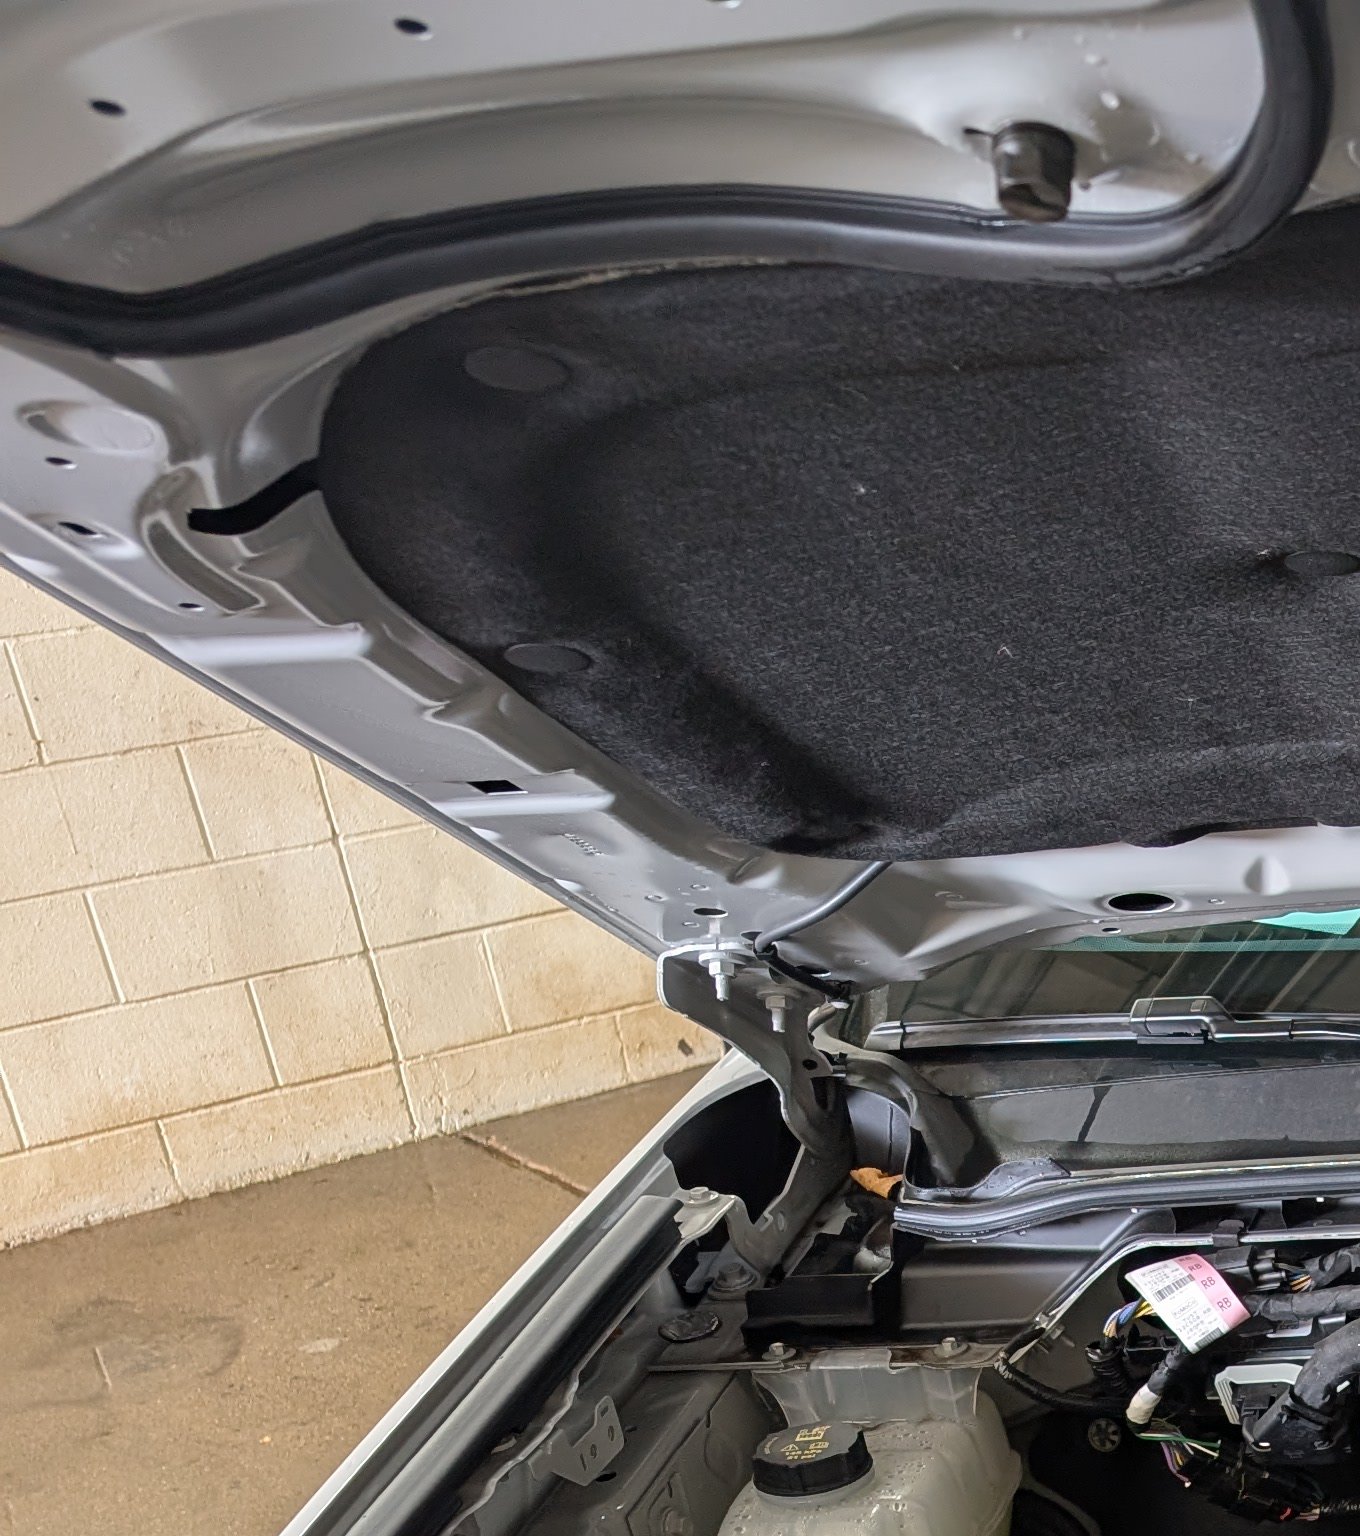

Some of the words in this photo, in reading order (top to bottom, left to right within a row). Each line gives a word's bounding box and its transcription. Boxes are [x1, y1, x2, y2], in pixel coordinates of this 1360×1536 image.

[1188, 1263, 1203, 1272] RB
[1201, 1276, 1216, 1290] RB
[1217, 1297, 1232, 1312] RB
